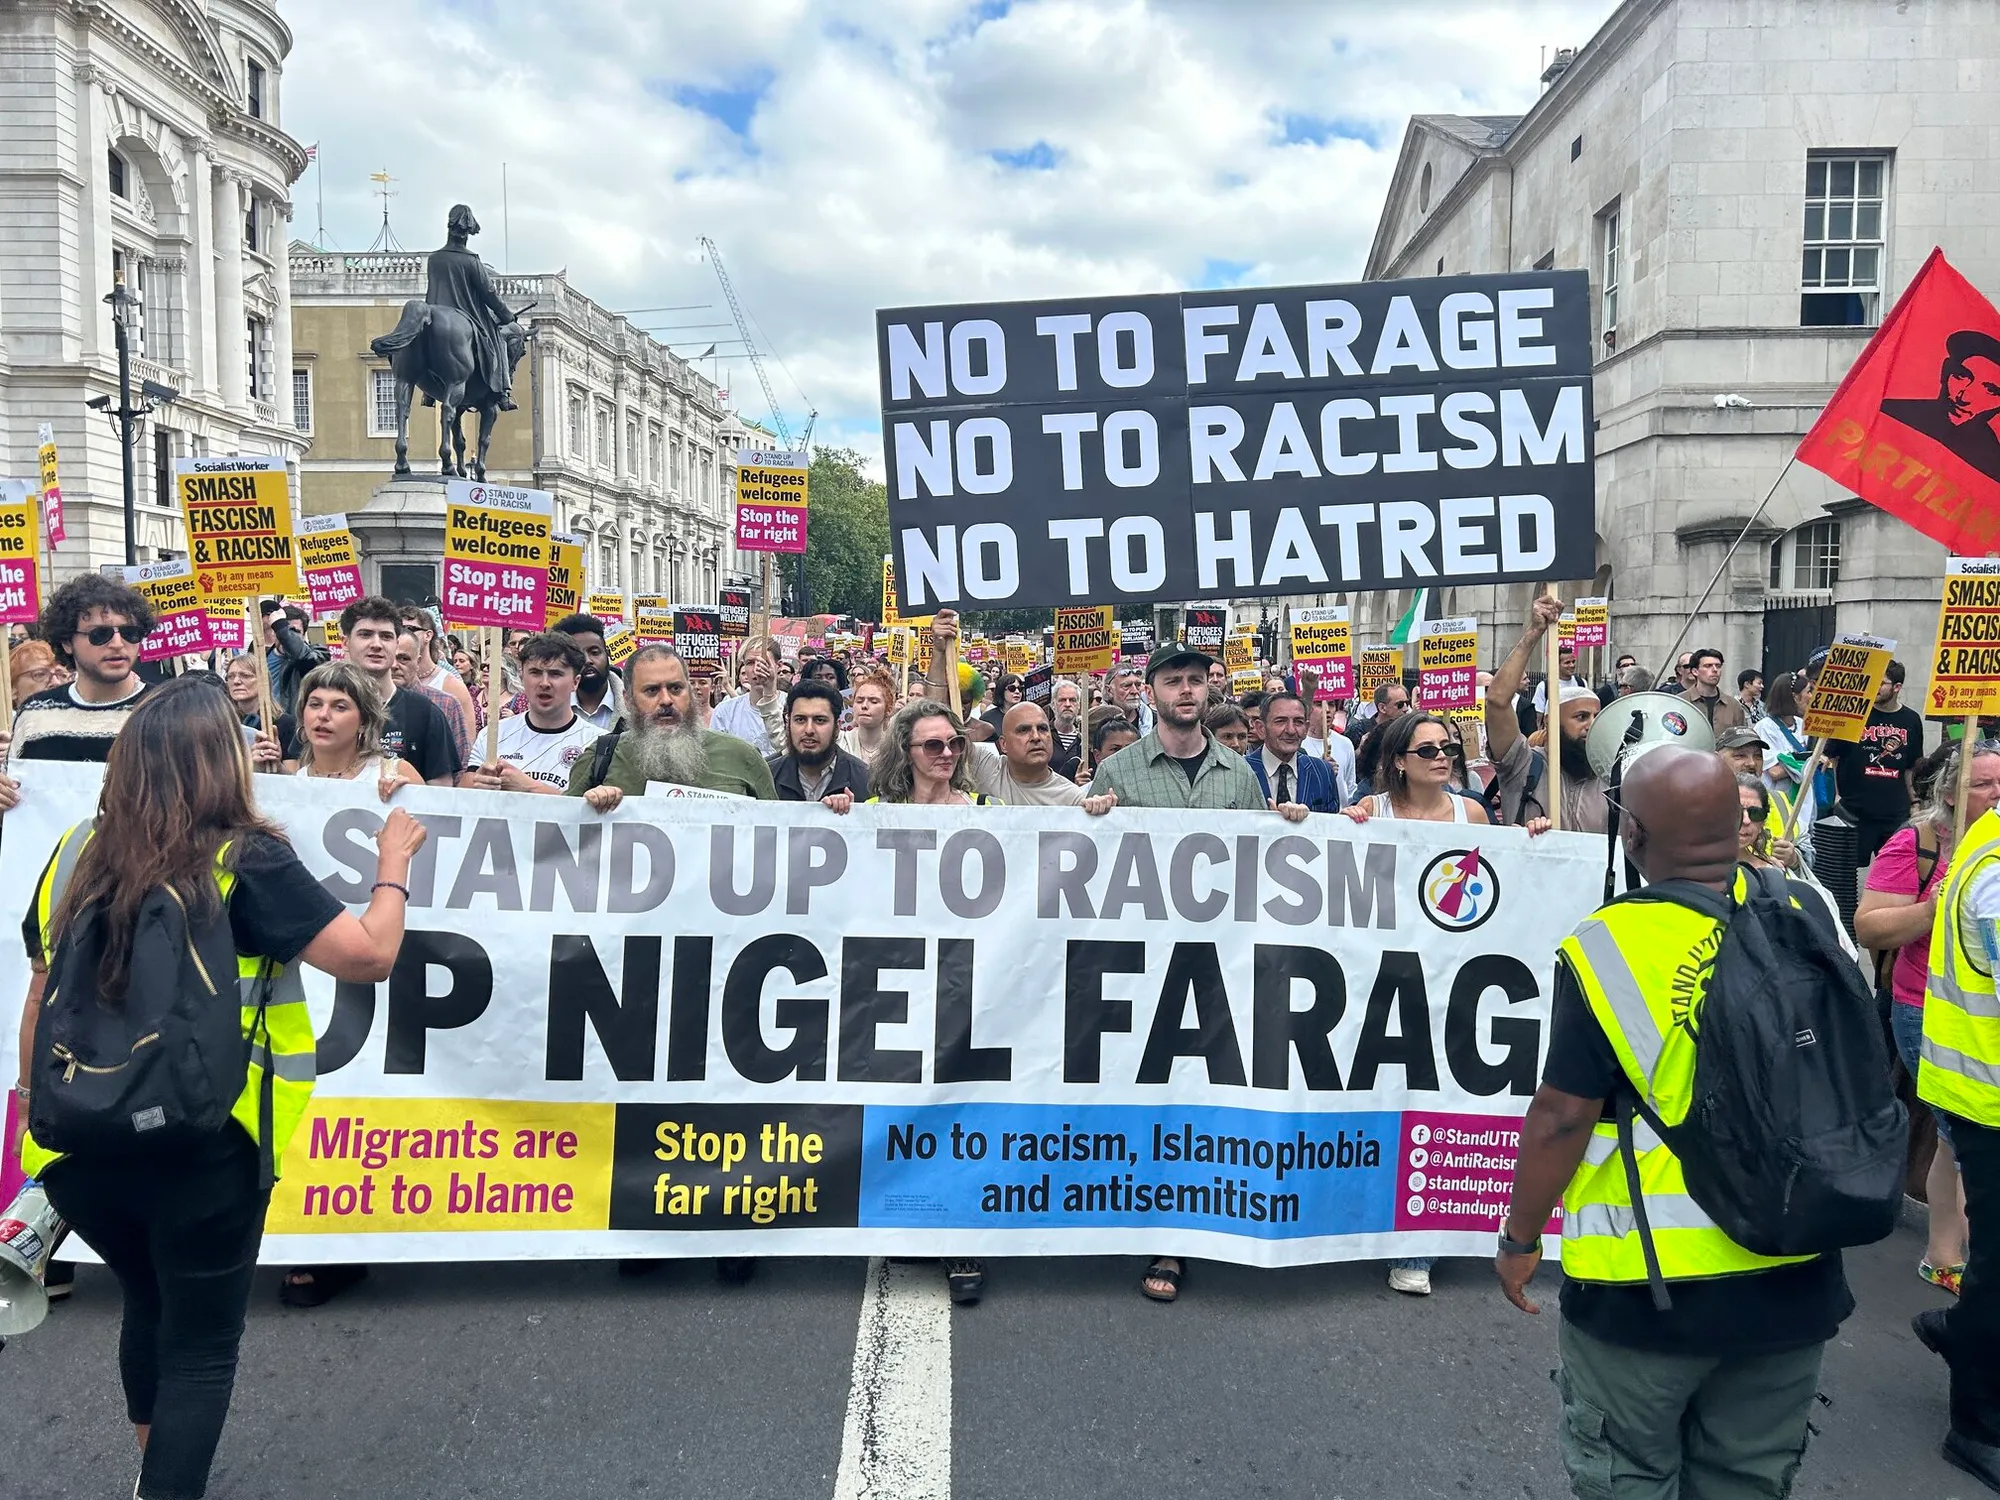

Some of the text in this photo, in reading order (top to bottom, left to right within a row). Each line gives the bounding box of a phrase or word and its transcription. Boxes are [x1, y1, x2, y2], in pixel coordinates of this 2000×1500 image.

[887, 287, 1557, 400] NO TO FARAGE
[894, 385, 1586, 500] NO TO RACISM
[740, 469, 805, 488] Refugees
[185, 476, 256, 501] SMASH
[488, 489, 528, 501] STAND UP
[740, 487, 802, 502] welcome
[489, 498, 532, 510] TO RACISM
[189, 506, 275, 532] FASCISM
[452, 509, 547, 538] Refugees
[740, 508, 799, 527] Stop the
[300, 535, 349, 551] Refugees
[740, 525, 798, 543] far right
[195, 536, 291, 563] & RACISM
[451, 535, 541, 560] welcome
[901, 494, 1556, 605] NO TO HATRED
[304, 551, 350, 566] welcome
[216, 571, 274, 583] By any means
[308, 570, 354, 587] Stop the
[449, 563, 536, 591] Stop the
[218, 582, 261, 592] necessary
[311, 589, 327, 602] far
[329, 585, 357, 603] right
[448, 586, 533, 616] far right
[634, 599, 657, 608] SMASH
[720, 605, 749, 615] REFUGEES
[175, 615, 199, 626] the
[1576, 607, 1606, 616] Refugees
[1057, 611, 1104, 631] FASCISM
[1576, 625, 1603, 635] Stop the
[1942, 614, 2000, 641] FASCIS
[141, 629, 202, 651] far right
[674, 633, 720, 647] REFUGEES
[1056, 635, 1066, 650] &
[1069, 630, 1110, 649] RACISM
[1188, 626, 1223, 636] REFUGEES
[1294, 626, 1348, 641] Refugees
[1575, 633, 1603, 643] far right
[1187, 635, 1222, 646] WELCOME
[1295, 642, 1346, 655] welcome
[1423, 638, 1475, 652] Refugees
[675, 645, 720, 659] WELCOME
[1362, 653, 1390, 663] SMASH
[1423, 652, 1472, 665] welcome
[1829, 647, 1870, 669] SMASH
[1326, 660, 1346, 673] the
[1362, 665, 1396, 675] FASCISM
[1936, 648, 1951, 675] &
[1318, 676, 1346, 692] right
[1362, 678, 1369, 687] &
[1422, 670, 1470, 687] Stop the
[1820, 670, 1871, 692] FASCISM
[1422, 685, 1469, 701] far right
[1949, 685, 1959, 698] By
[1960, 687, 1975, 698] any
[1811, 692, 1870, 715] & RACISM
[319, 807, 1397, 930] STAND UP TO RACISM
[545, 933, 1012, 1084] NIGEL
[1063, 939, 1548, 1097] FARAG
[309, 1117, 578, 1169] Migrants are
[654, 1121, 823, 1173] Stop the
[1432, 1128, 1520, 1148] @StandUTR
[886, 1122, 1380, 1180] No to racism, Islamophobia
[303, 1172, 574, 1215] not to blame
[654, 1173, 818, 1223] far right
[981, 1174, 1300, 1223] and antisemitism
